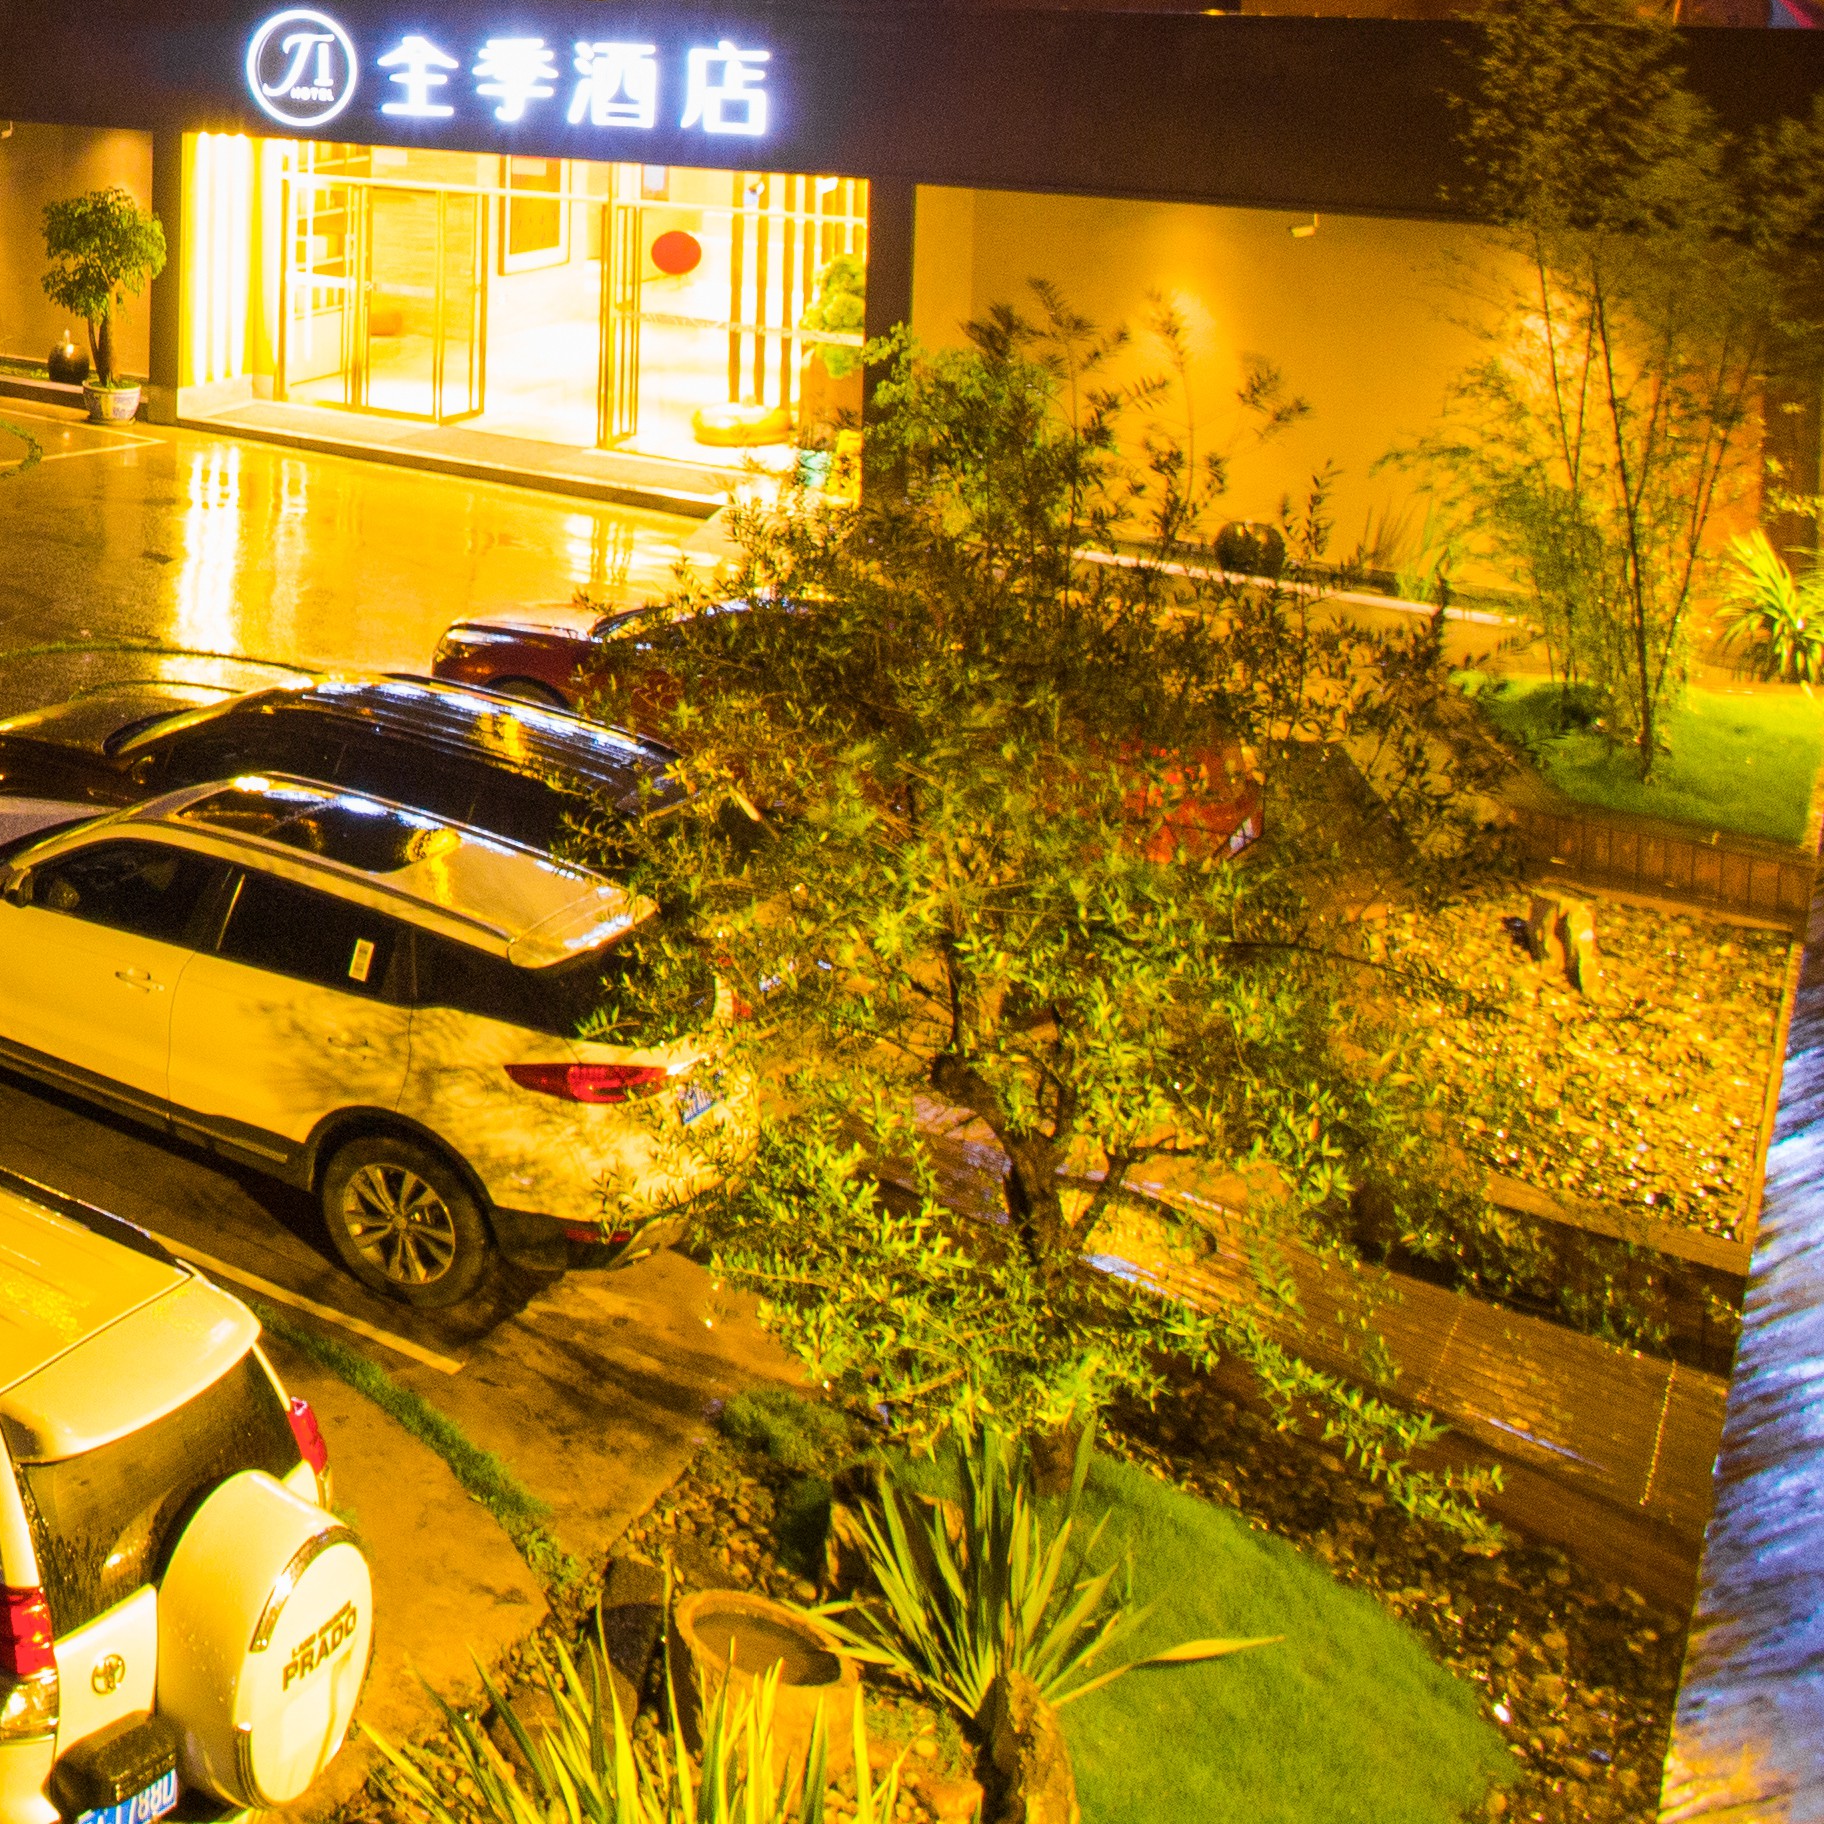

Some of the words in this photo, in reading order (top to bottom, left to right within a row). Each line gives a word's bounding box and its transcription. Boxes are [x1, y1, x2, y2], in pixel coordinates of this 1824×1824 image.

[377, 35, 771, 136] 全季酒店
[282, 1606, 357, 1692] PRADO
